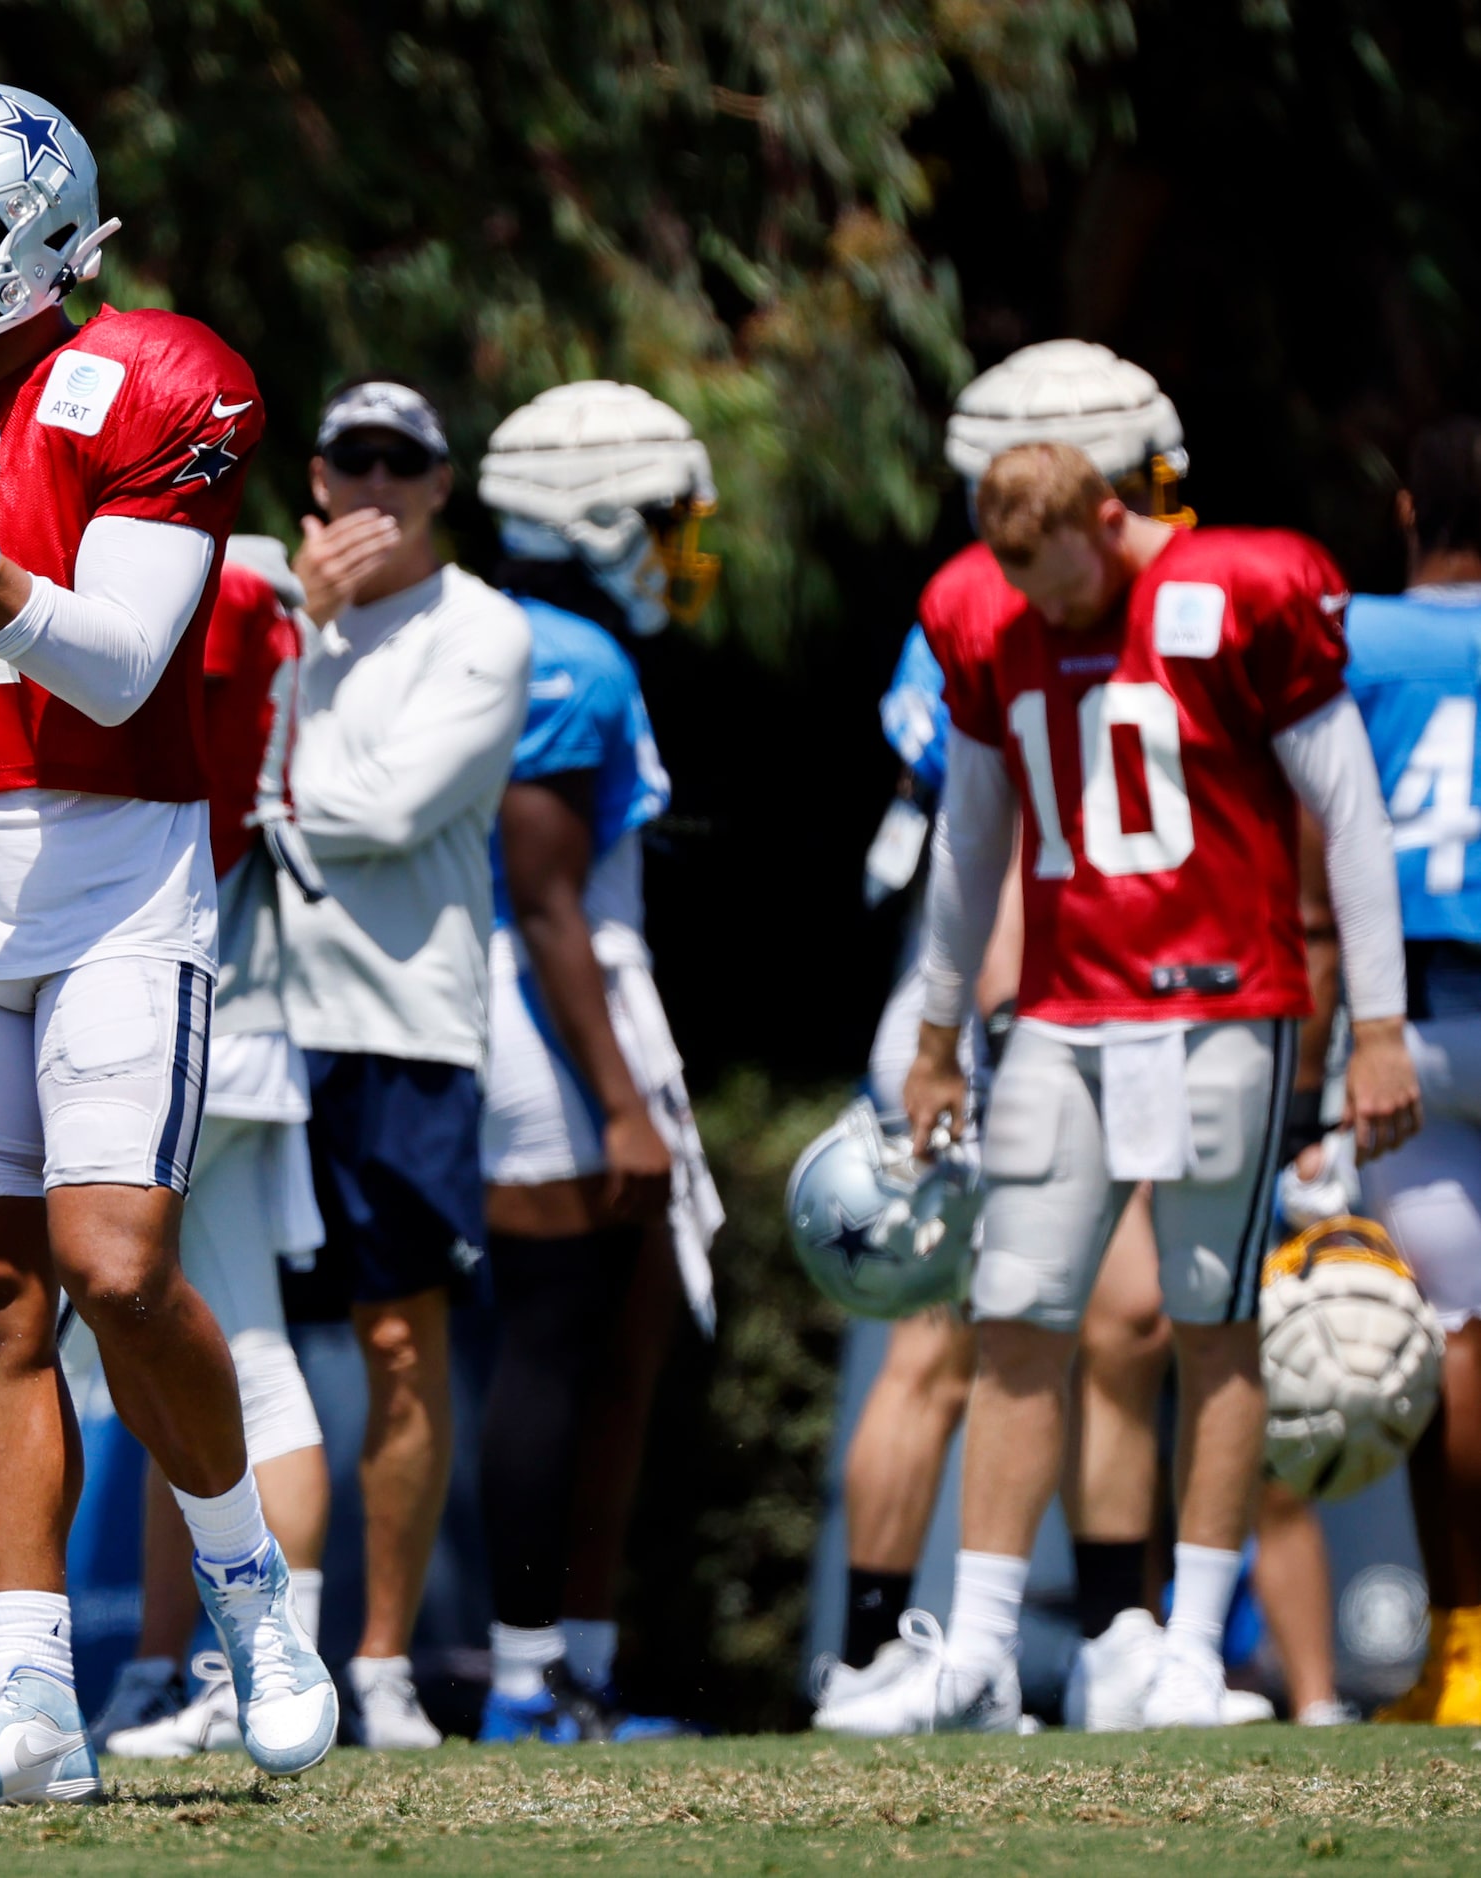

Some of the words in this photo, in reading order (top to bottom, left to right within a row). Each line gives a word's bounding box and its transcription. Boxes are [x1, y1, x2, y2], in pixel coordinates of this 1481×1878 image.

[50, 400, 92, 422] AT&T
[1007, 681, 1195, 880] 10
[1388, 696, 1481, 894] 4
